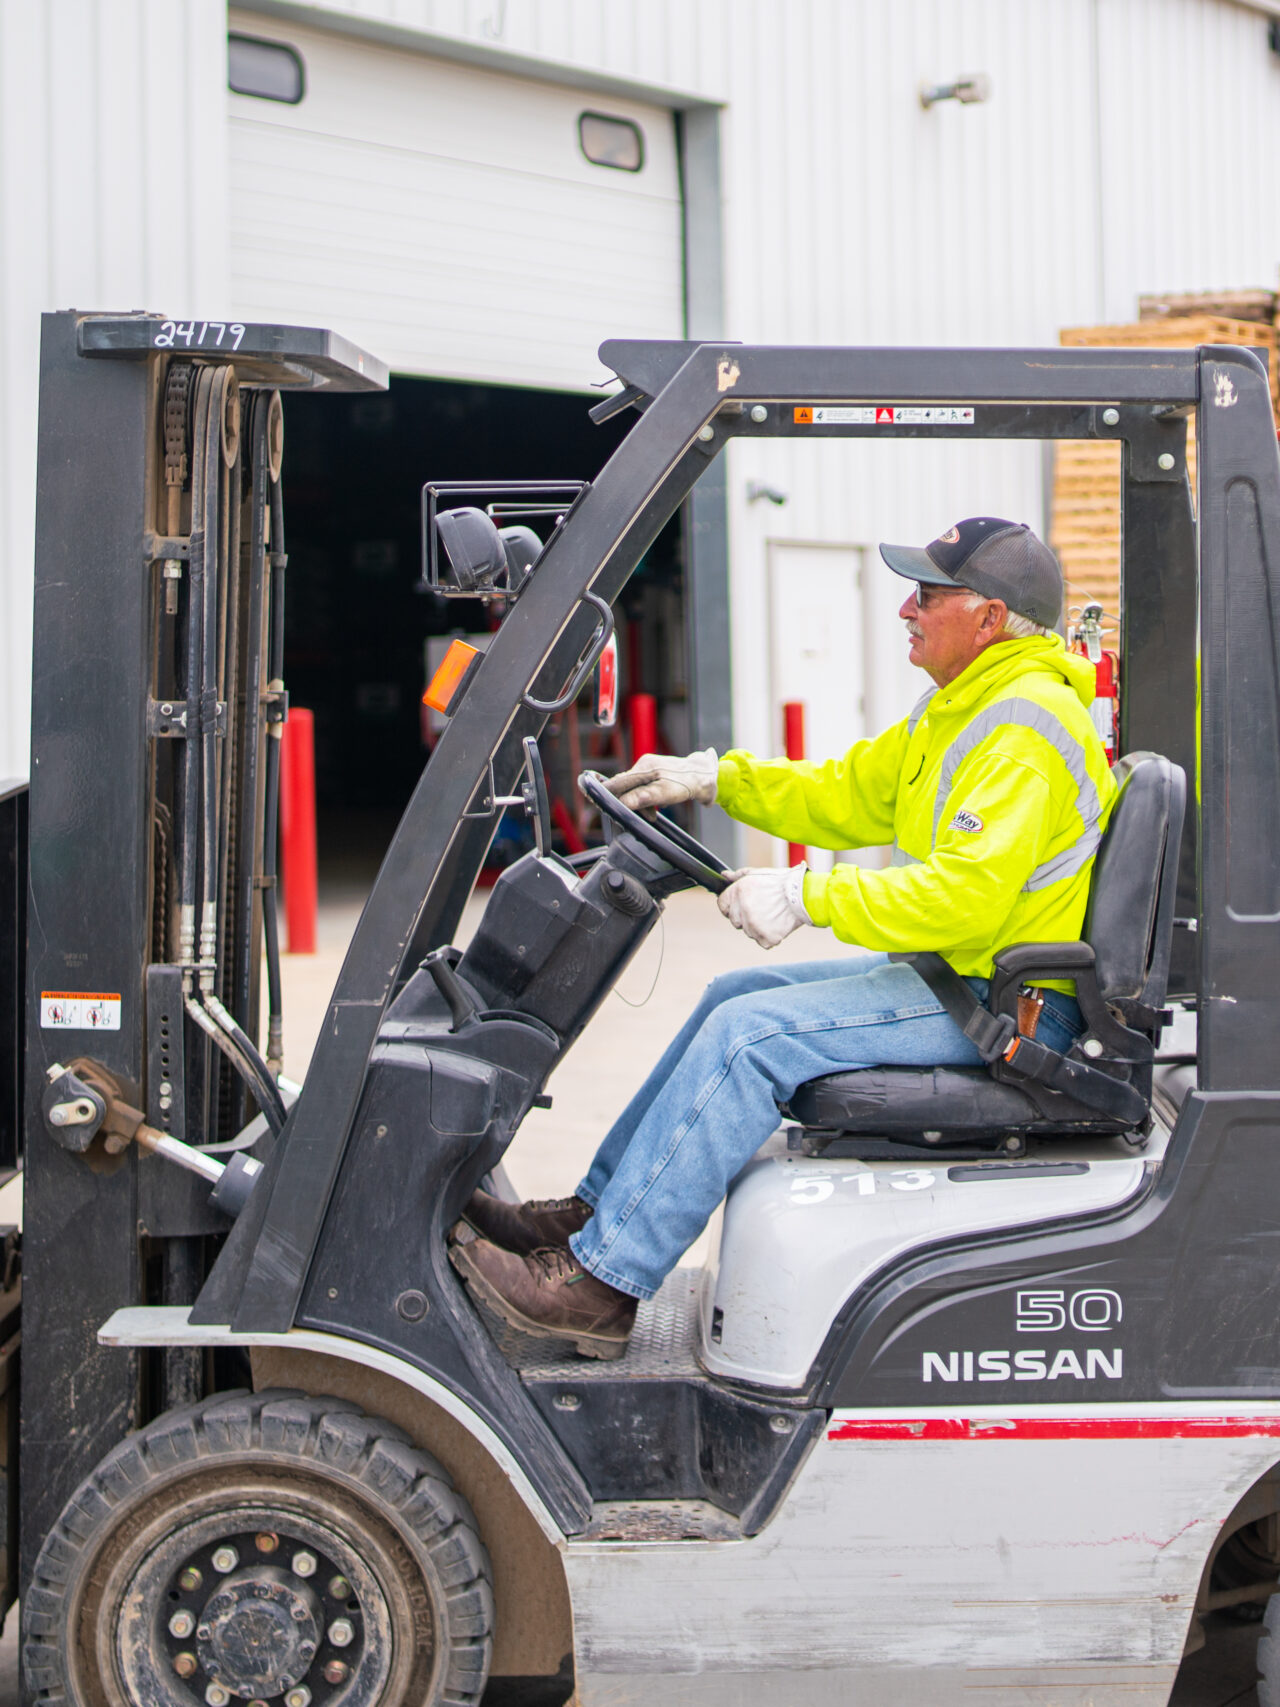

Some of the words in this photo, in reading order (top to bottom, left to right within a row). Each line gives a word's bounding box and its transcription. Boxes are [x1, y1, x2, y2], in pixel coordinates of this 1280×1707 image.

[154, 321, 246, 351] 24179
[952, 810, 979, 829] Way
[790, 1168, 936, 1205] 513
[1016, 1289, 1123, 1332] 50
[922, 1348, 1123, 1382] NISSAN
